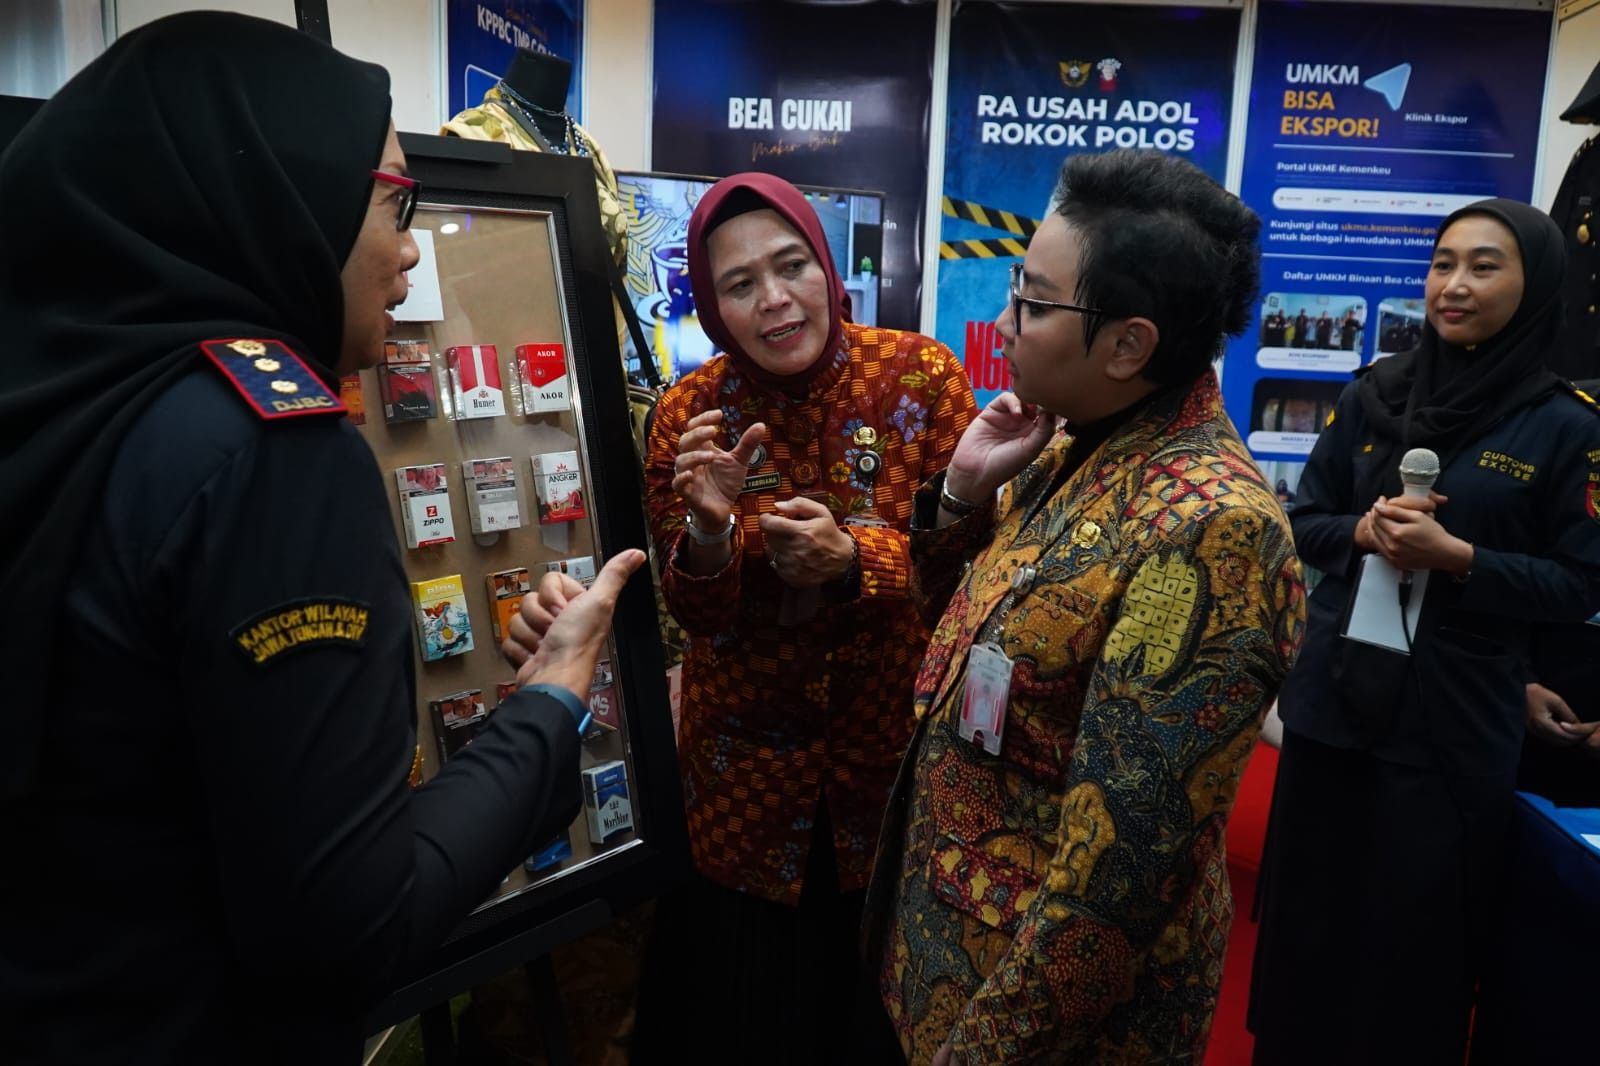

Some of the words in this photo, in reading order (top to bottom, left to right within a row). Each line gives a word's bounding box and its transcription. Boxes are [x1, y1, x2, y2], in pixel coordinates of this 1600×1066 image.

[477, 4, 512, 44] KPPBC
[1286, 62, 1360, 86] UMKM
[977, 94, 1019, 118] RA
[1026, 96, 1108, 121] USAH
[1114, 99, 1199, 125] ADOL
[1283, 90, 1335, 111] BISA
[728, 97, 774, 130] BEA
[781, 99, 853, 132] CUKAI
[1405, 112, 1433, 122] Klinik
[1434, 114, 1468, 124] Ekspor
[981, 121, 1088, 147] ROKOK
[1095, 125, 1196, 152] POLOS
[1280, 115, 1380, 138] EKSPOR!
[1276, 161, 1307, 171] Portal
[1308, 162, 1337, 172] UKME
[1339, 164, 1391, 174] Kemenkeu
[1270, 219, 1315, 231] Kunjungi
[1316, 220, 1338, 230] situs
[1269, 232, 1298, 241] untuk
[1300, 233, 1343, 244] berbagai
[1344, 235, 1401, 245] kemudahan
[1403, 237, 1435, 247] UMKM
[1283, 270, 1313, 280] Daftar
[1315, 272, 1347, 282] UMKM
[1348, 273, 1382, 283] Binaan
[1384, 274, 1402, 284] Bea
[965, 320, 1013, 392] NG
[271, 396, 334, 412] DJBC
[540, 391, 563, 400] AKOR
[1479, 458, 1532, 481] EXCISE
[1482, 450, 1536, 473] CUSTOMS
[548, 472, 578, 484] ANGKER
[423, 517, 445, 527] ZIPPO
[238, 609, 302, 650] KANTOR
[303, 603, 368, 626] WILAYAH
[252, 632, 289, 664] JAWA
